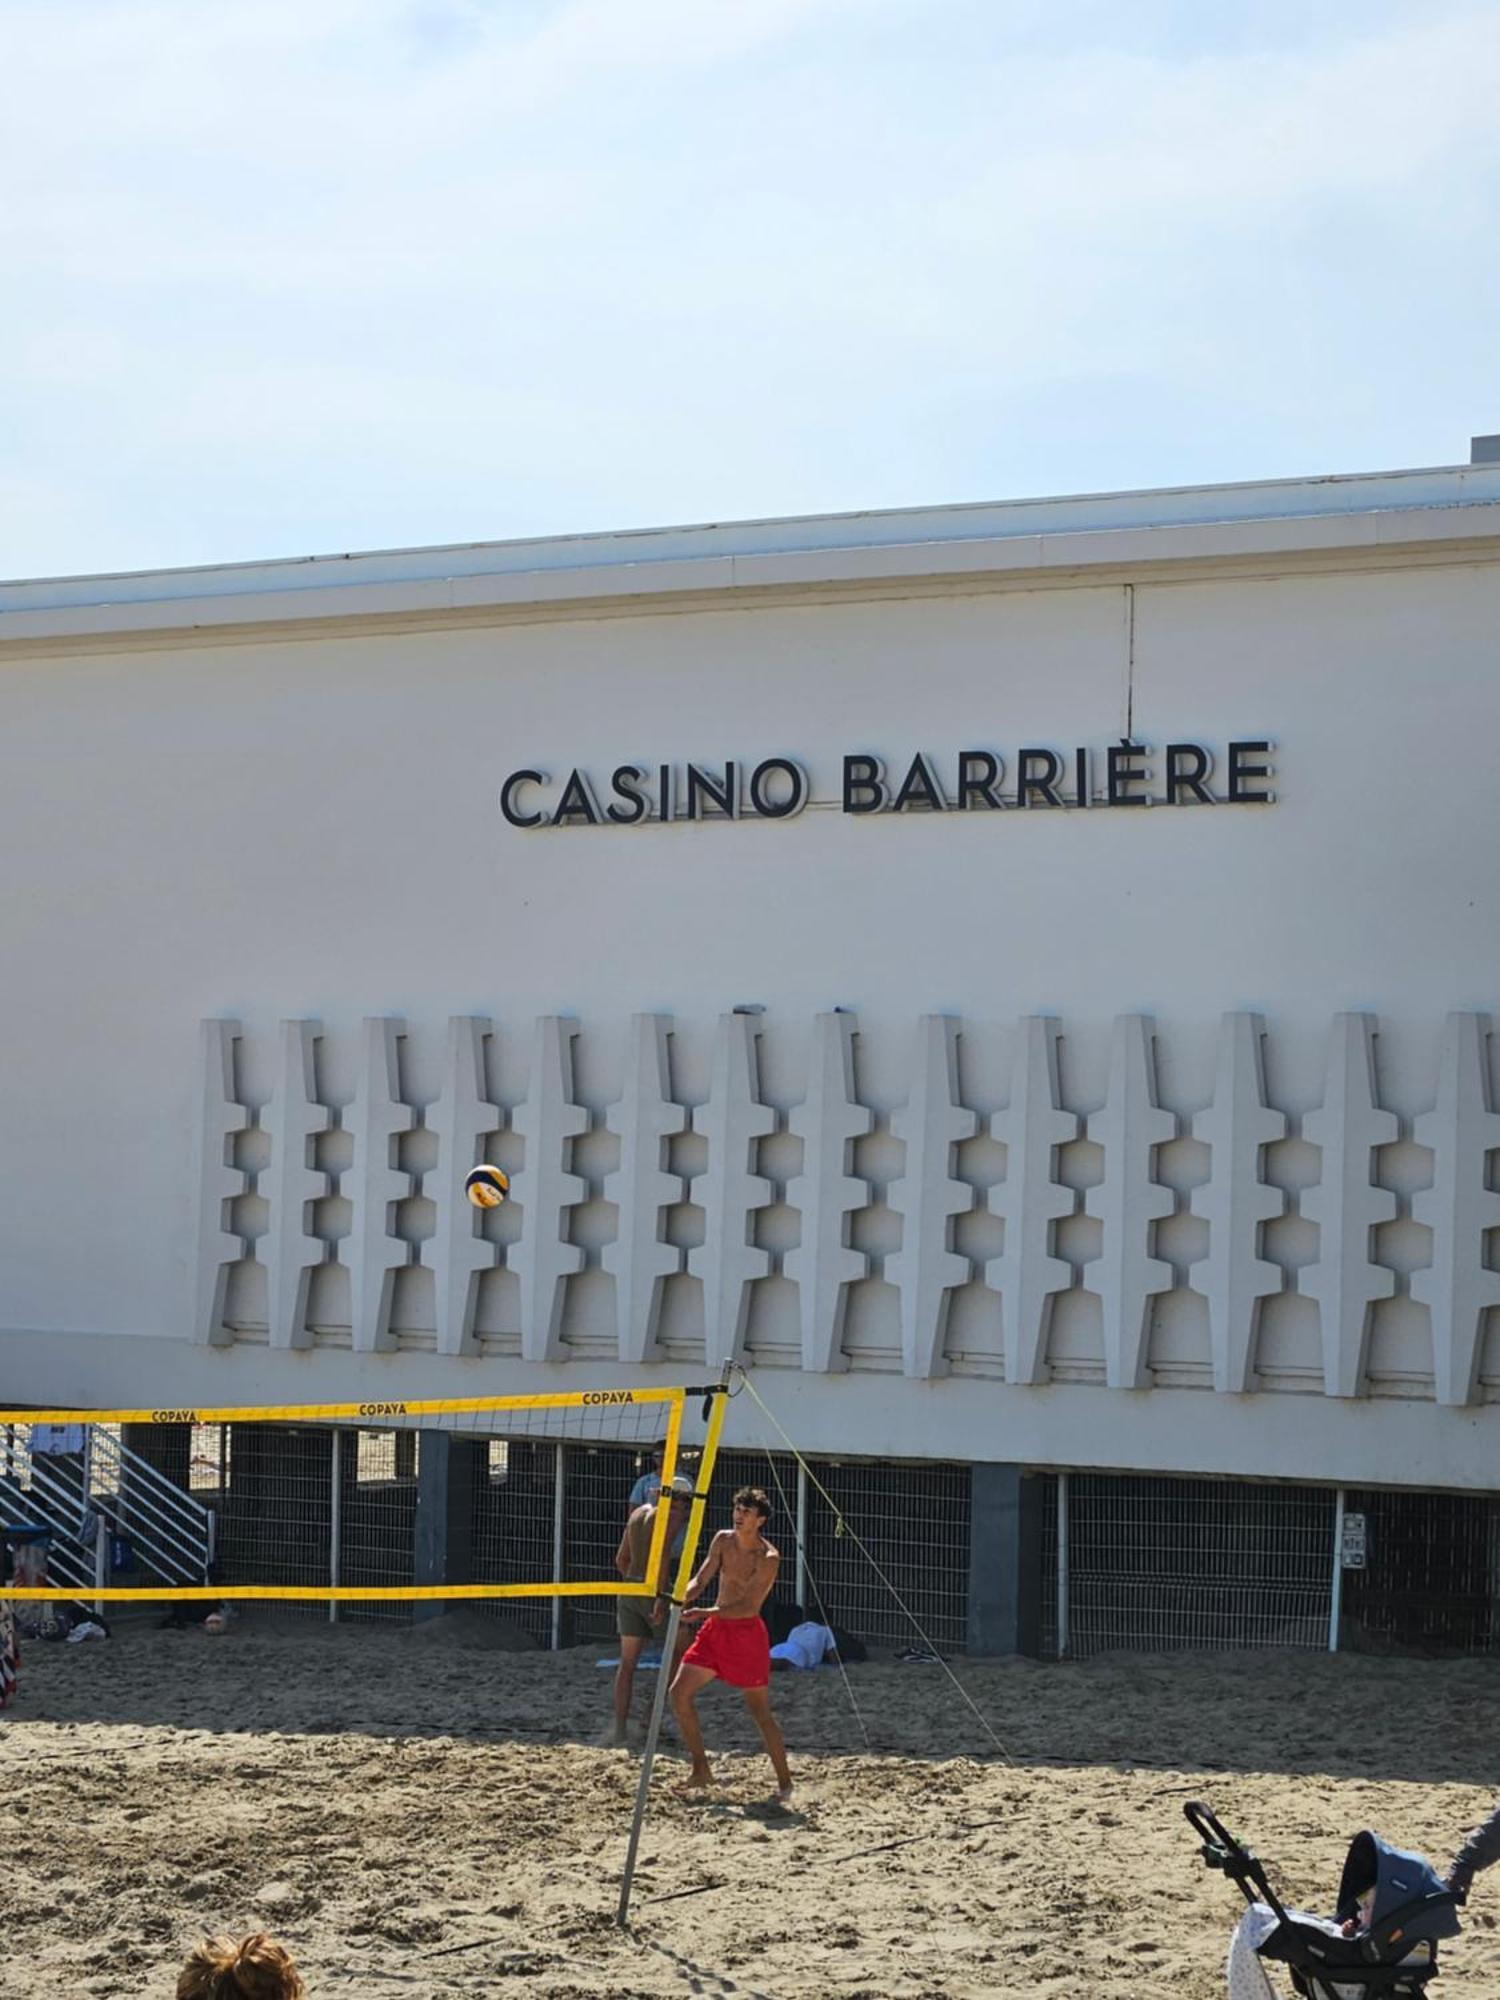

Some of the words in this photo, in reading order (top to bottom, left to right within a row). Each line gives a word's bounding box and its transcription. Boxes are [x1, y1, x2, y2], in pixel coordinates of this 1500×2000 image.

[500, 758, 805, 828] CASINO
[843, 738, 1273, 813] BARRIÈRE
[583, 1391, 633, 1405] COPAYA
[151, 1410, 196, 1422] COPAYA
[359, 1403, 407, 1416] COPAYA
